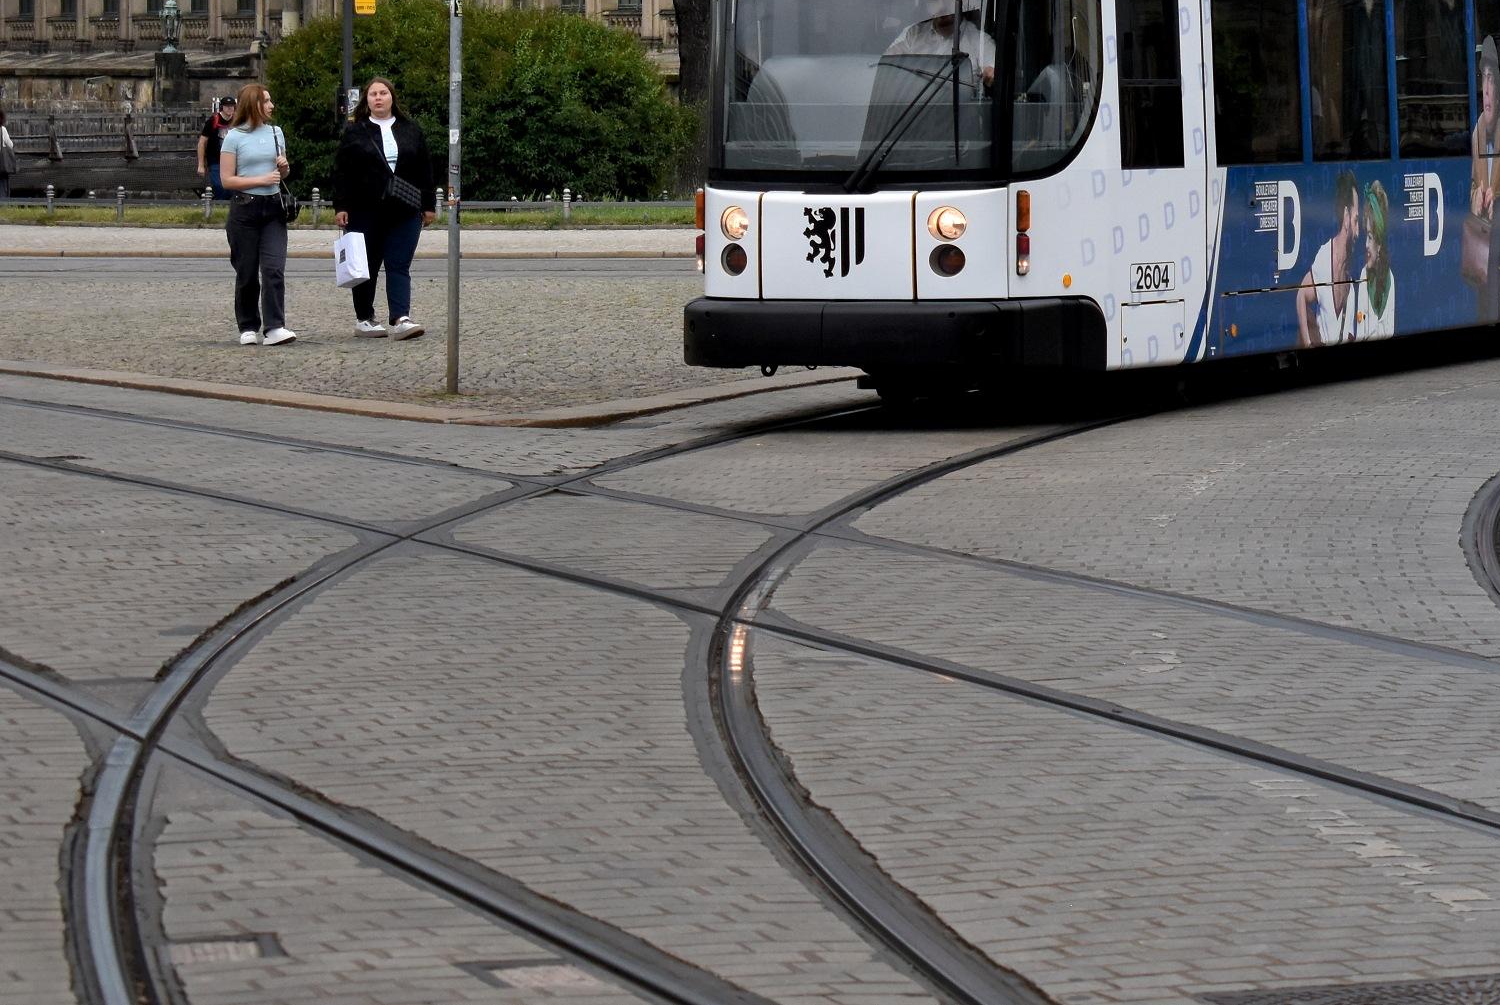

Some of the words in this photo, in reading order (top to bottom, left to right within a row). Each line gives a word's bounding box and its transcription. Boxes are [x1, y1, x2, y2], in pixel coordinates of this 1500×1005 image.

[1404, 176, 1423, 188] BOULEVARD
[1255, 184, 1277, 196] BOULEVARD
[1409, 191, 1423, 202] THEATER
[1261, 201, 1277, 212] THEATER
[1408, 206, 1423, 218] DRESDEN
[1259, 216, 1277, 229] DRESDEN
[1136, 264, 1170, 290] 2604
